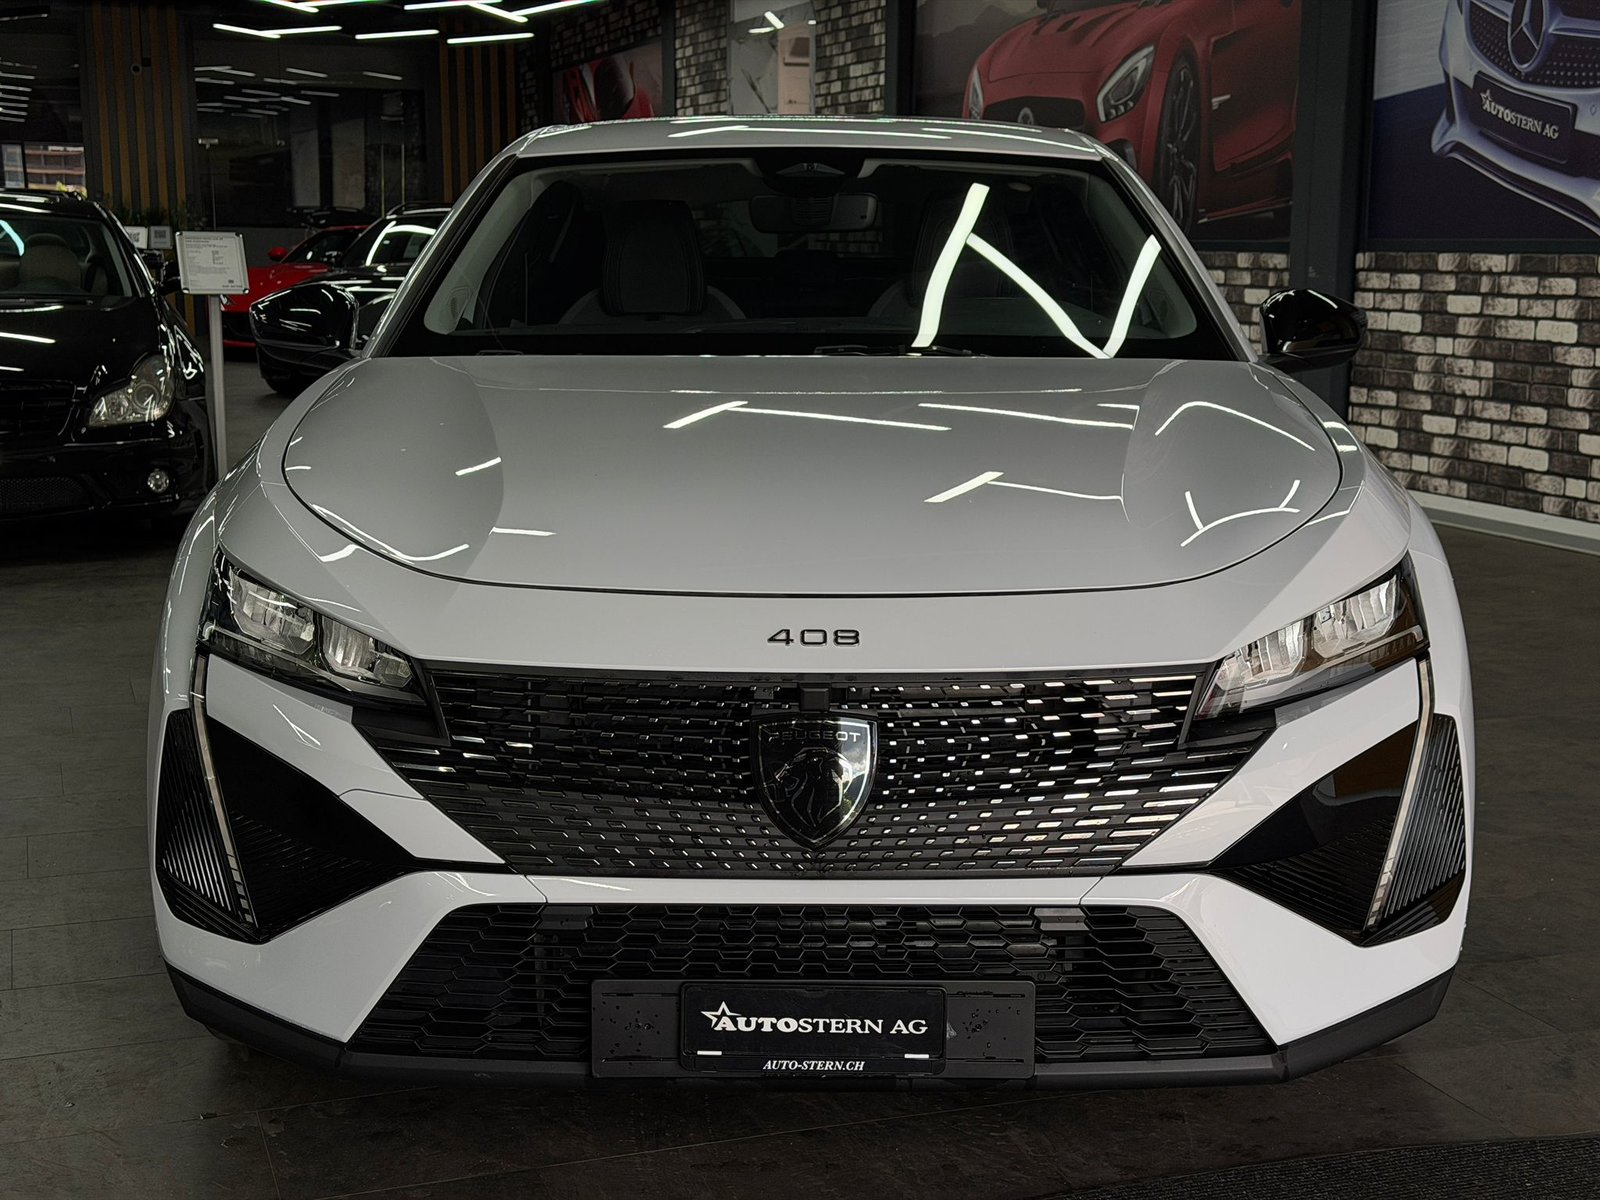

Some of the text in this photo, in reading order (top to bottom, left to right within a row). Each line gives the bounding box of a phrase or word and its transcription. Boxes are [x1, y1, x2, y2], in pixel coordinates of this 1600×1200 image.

[1483, 100, 1559, 139] AUTOSTERN AG
[767, 629, 860, 646] 408
[714, 1016, 928, 1034] AUTOSTERN AG
[763, 1060, 865, 1071] AUTO-STERN.CH
